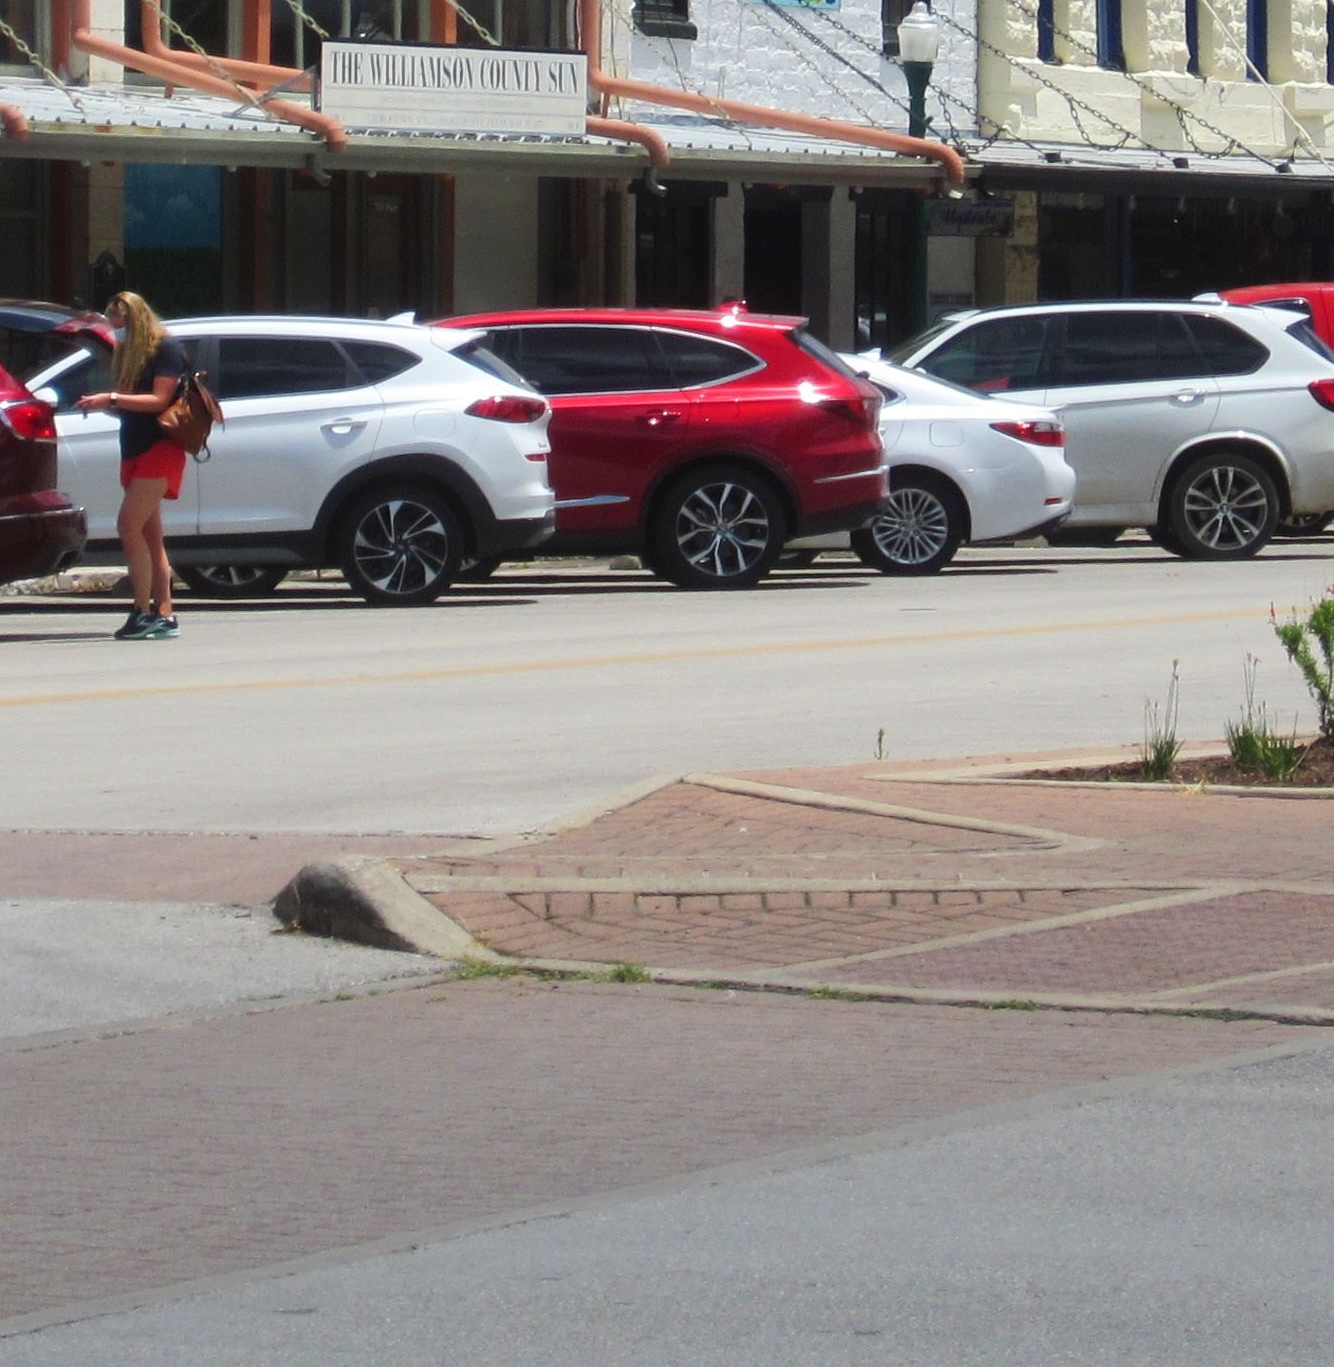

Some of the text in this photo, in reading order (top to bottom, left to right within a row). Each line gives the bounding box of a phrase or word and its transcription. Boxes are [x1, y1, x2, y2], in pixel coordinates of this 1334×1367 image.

[331, 51, 580, 94] THE WILLIAMSON COUNTY SUN
